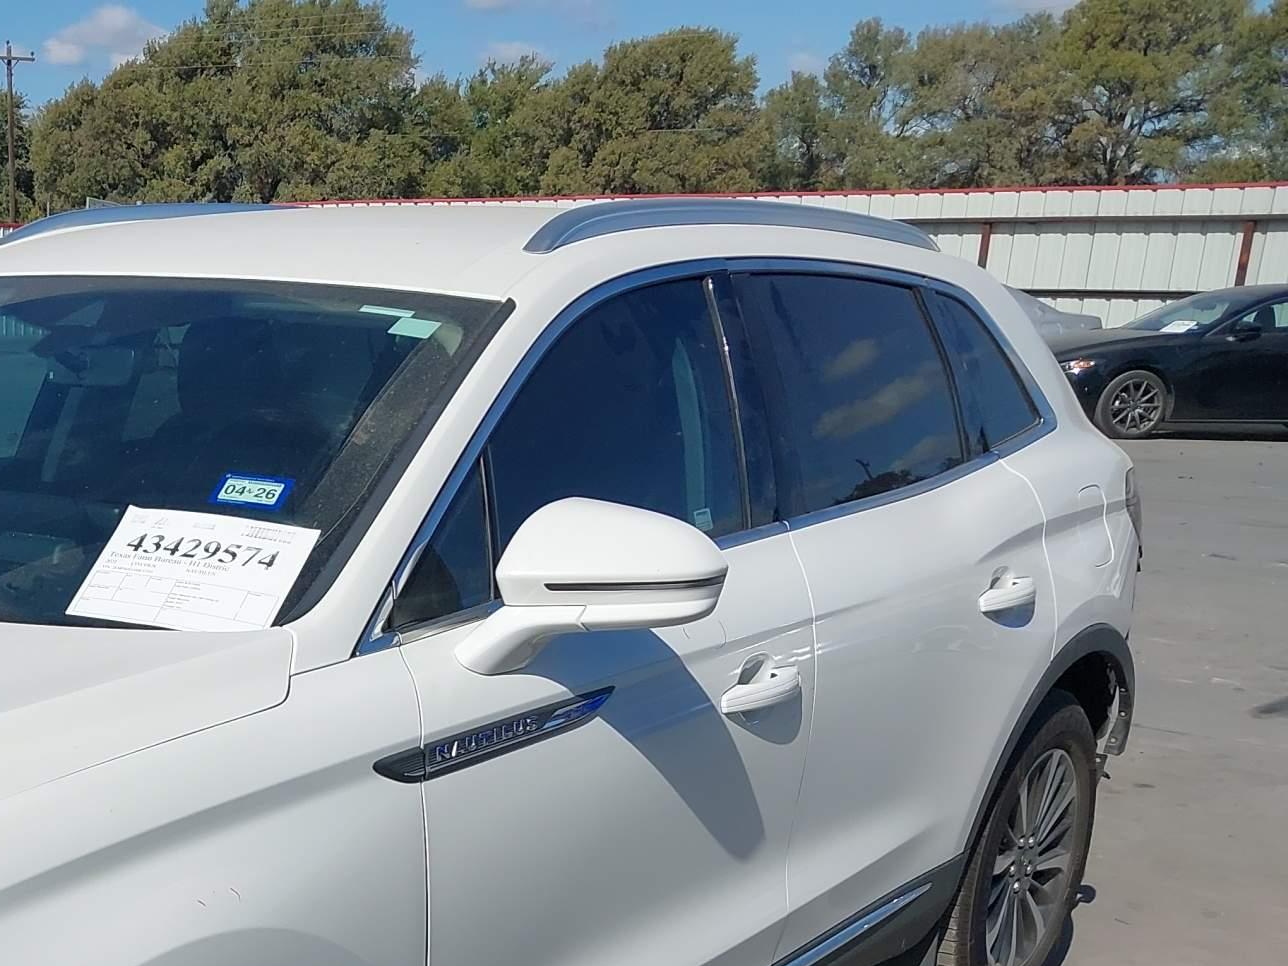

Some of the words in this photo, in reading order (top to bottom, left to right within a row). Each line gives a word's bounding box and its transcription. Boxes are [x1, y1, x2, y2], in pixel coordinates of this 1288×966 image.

[223, 484, 247, 497] 04
[253, 487, 278, 500] 26
[110, 551, 131, 559] Texas
[126, 533, 280, 570] 43429574
[435, 716, 539, 762] NAUTILUS
